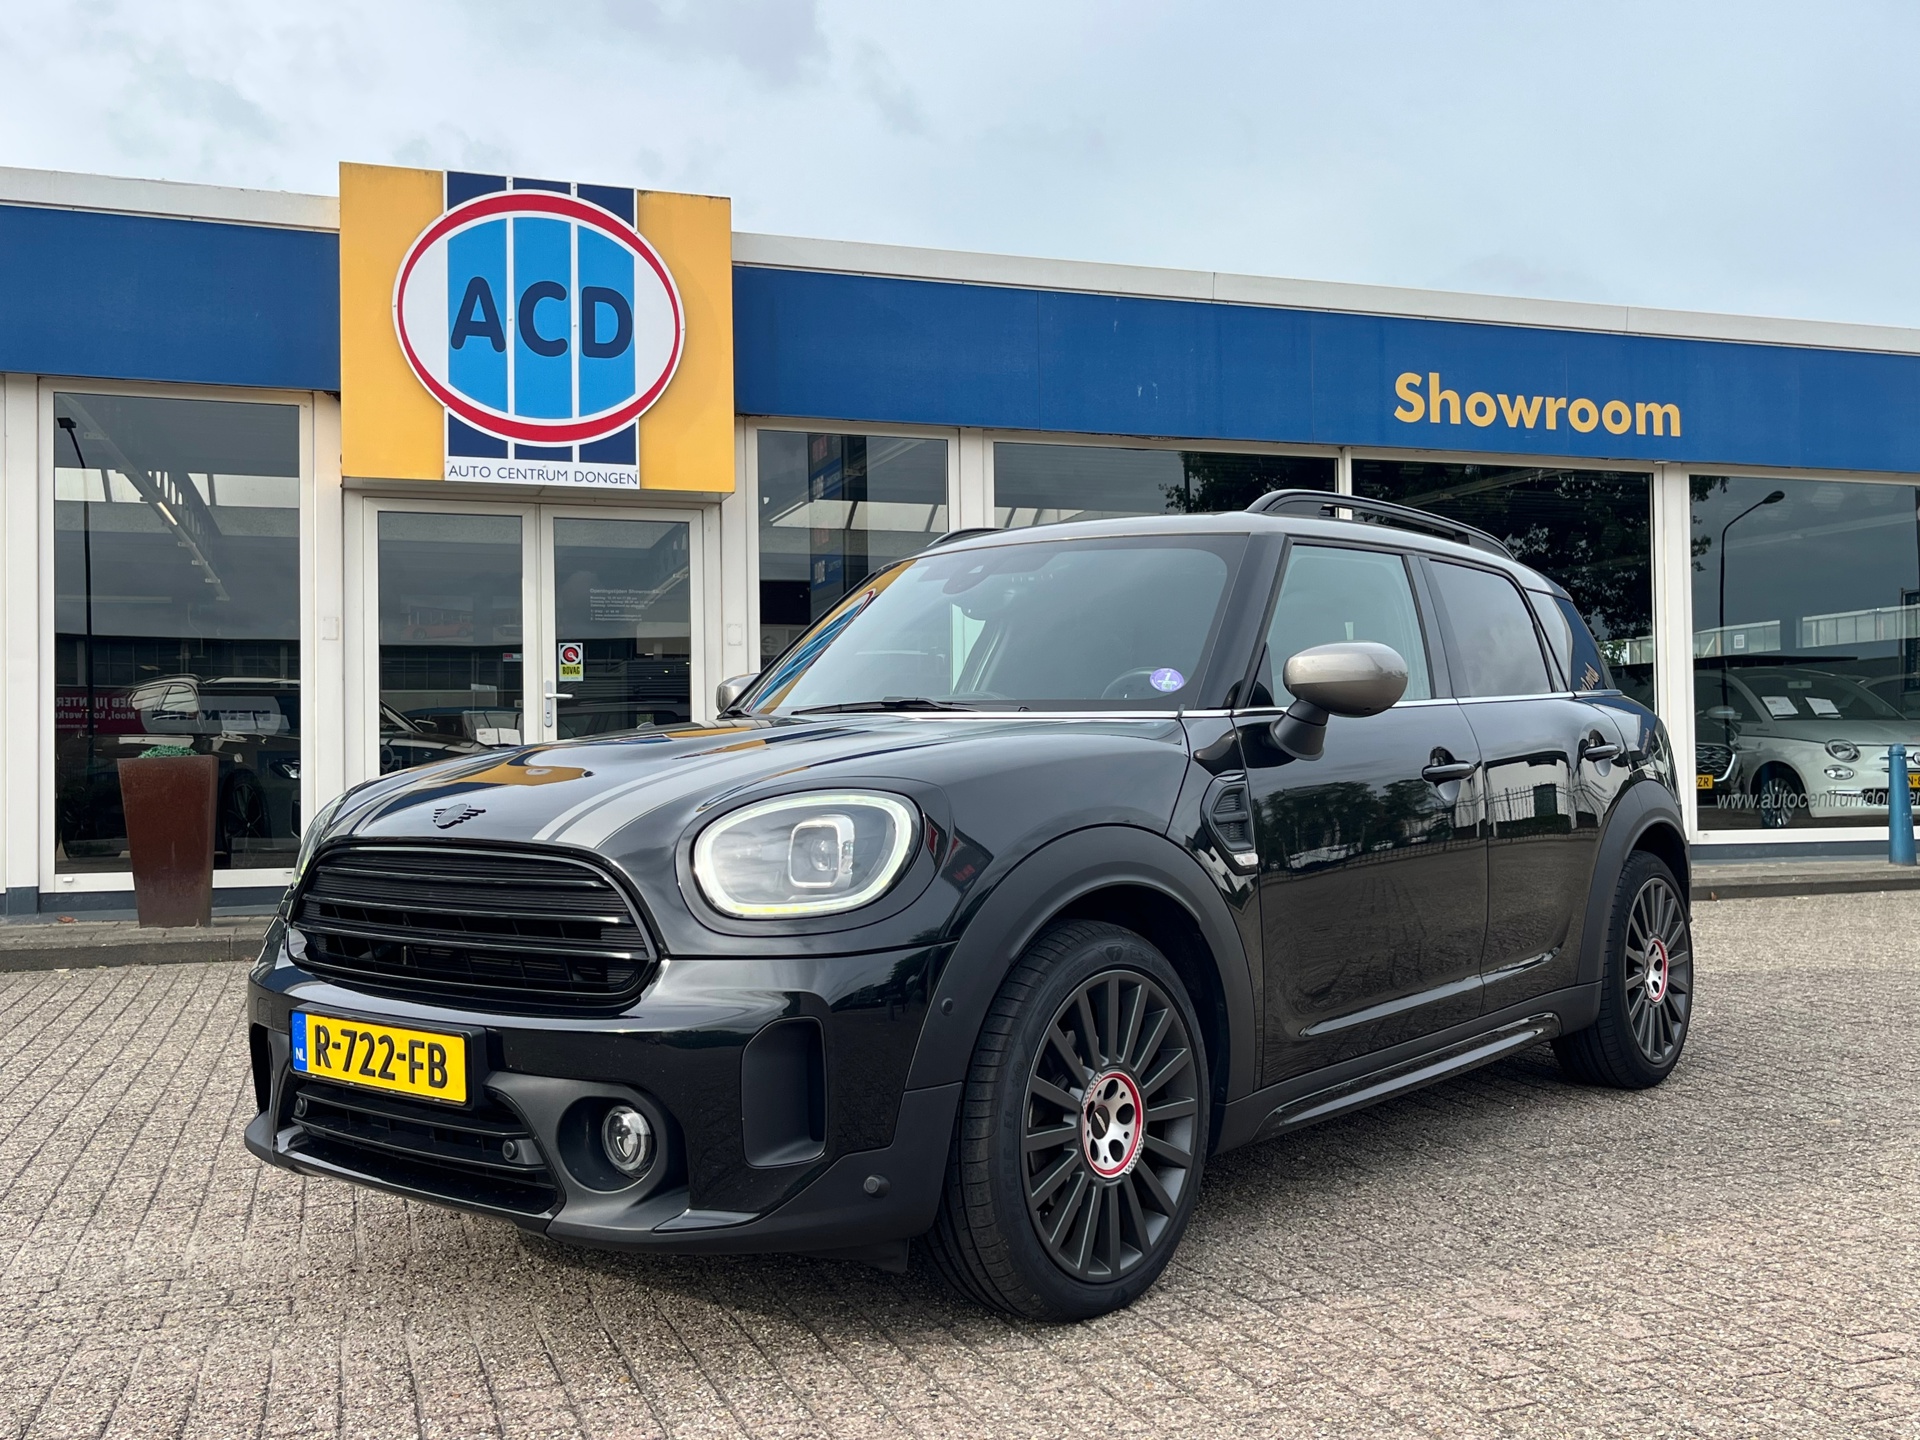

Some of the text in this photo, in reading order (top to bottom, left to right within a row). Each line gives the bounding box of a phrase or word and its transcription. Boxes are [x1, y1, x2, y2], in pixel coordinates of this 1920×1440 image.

[450, 276, 633, 359] ACD
[1393, 372, 1681, 437] Showroom
[448, 465, 638, 485] AUTO CENTRUM DONGEN
[562, 666, 580, 675] BOVAG
[296, 1047, 306, 1062] NL
[314, 1024, 448, 1089] R-722-FB
